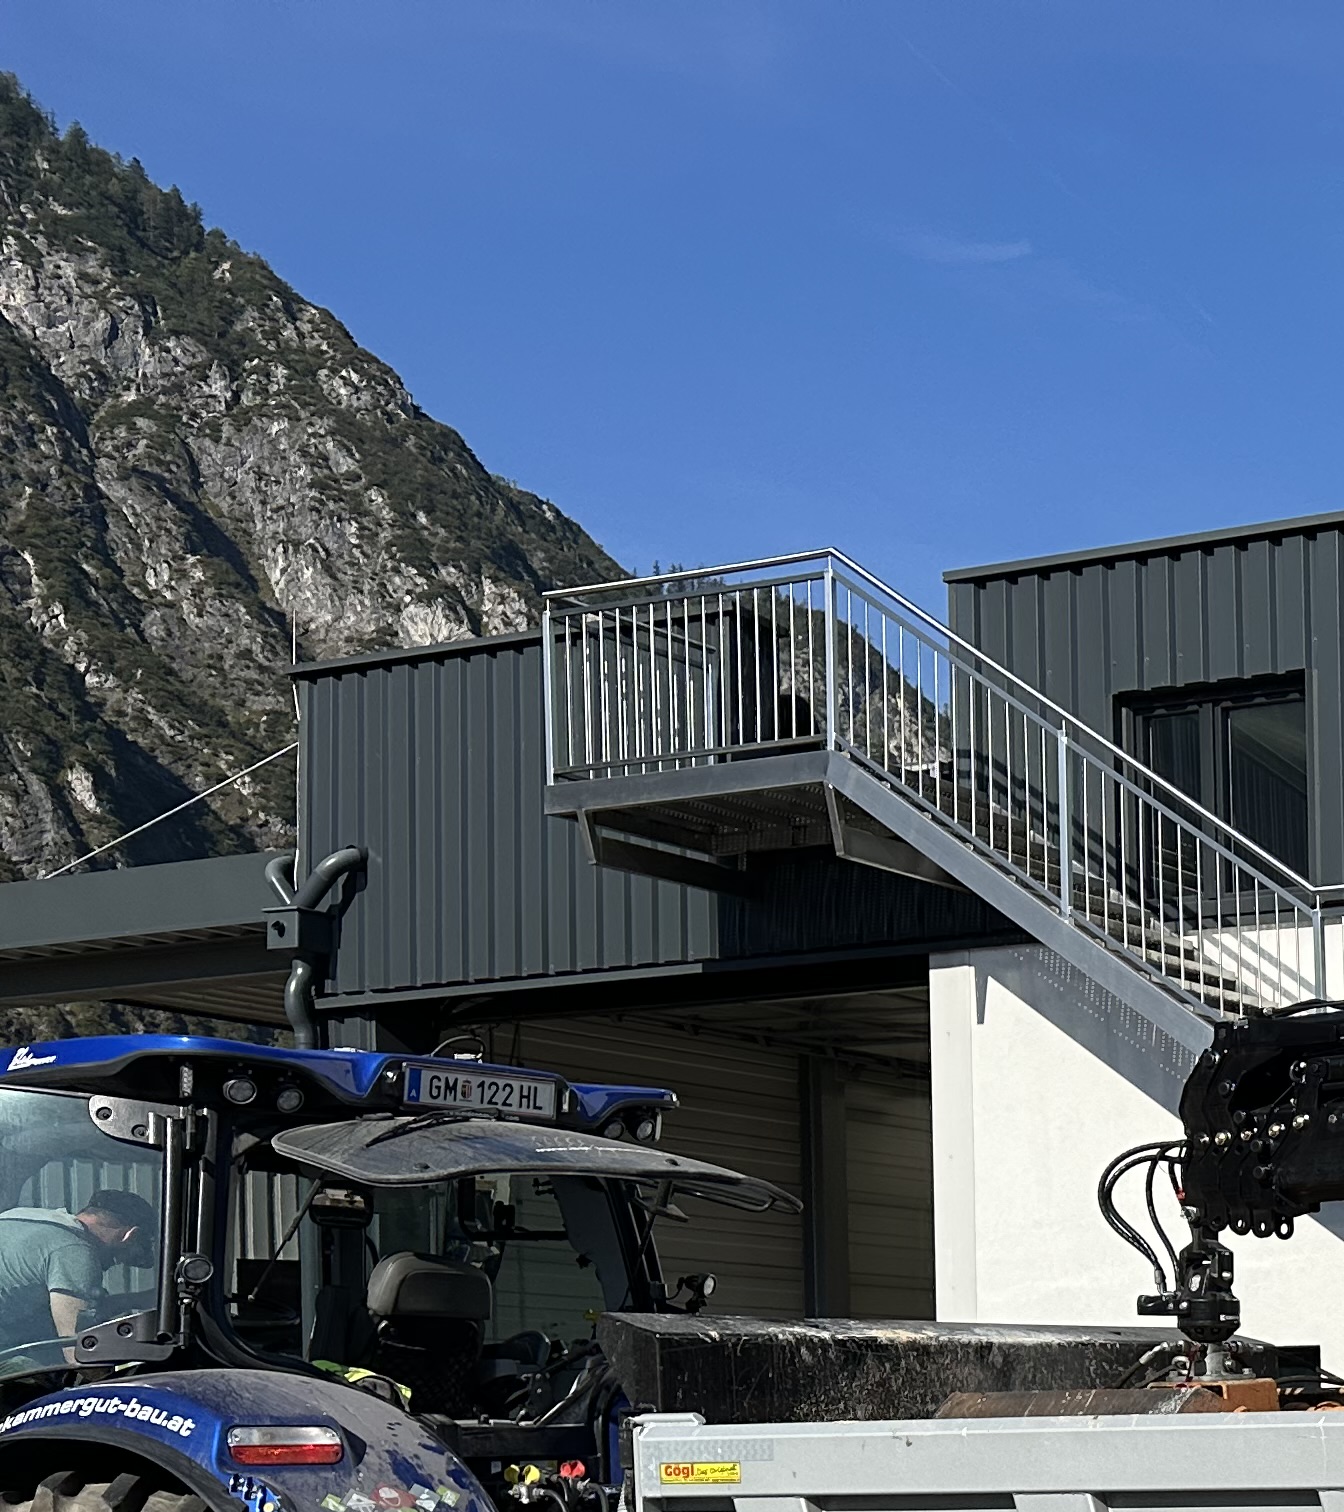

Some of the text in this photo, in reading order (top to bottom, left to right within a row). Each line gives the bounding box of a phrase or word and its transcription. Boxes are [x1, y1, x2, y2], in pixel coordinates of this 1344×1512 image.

[409, 1074, 544, 1111] A GM 122 HL
[664, 1463, 694, 1479] Gögl
